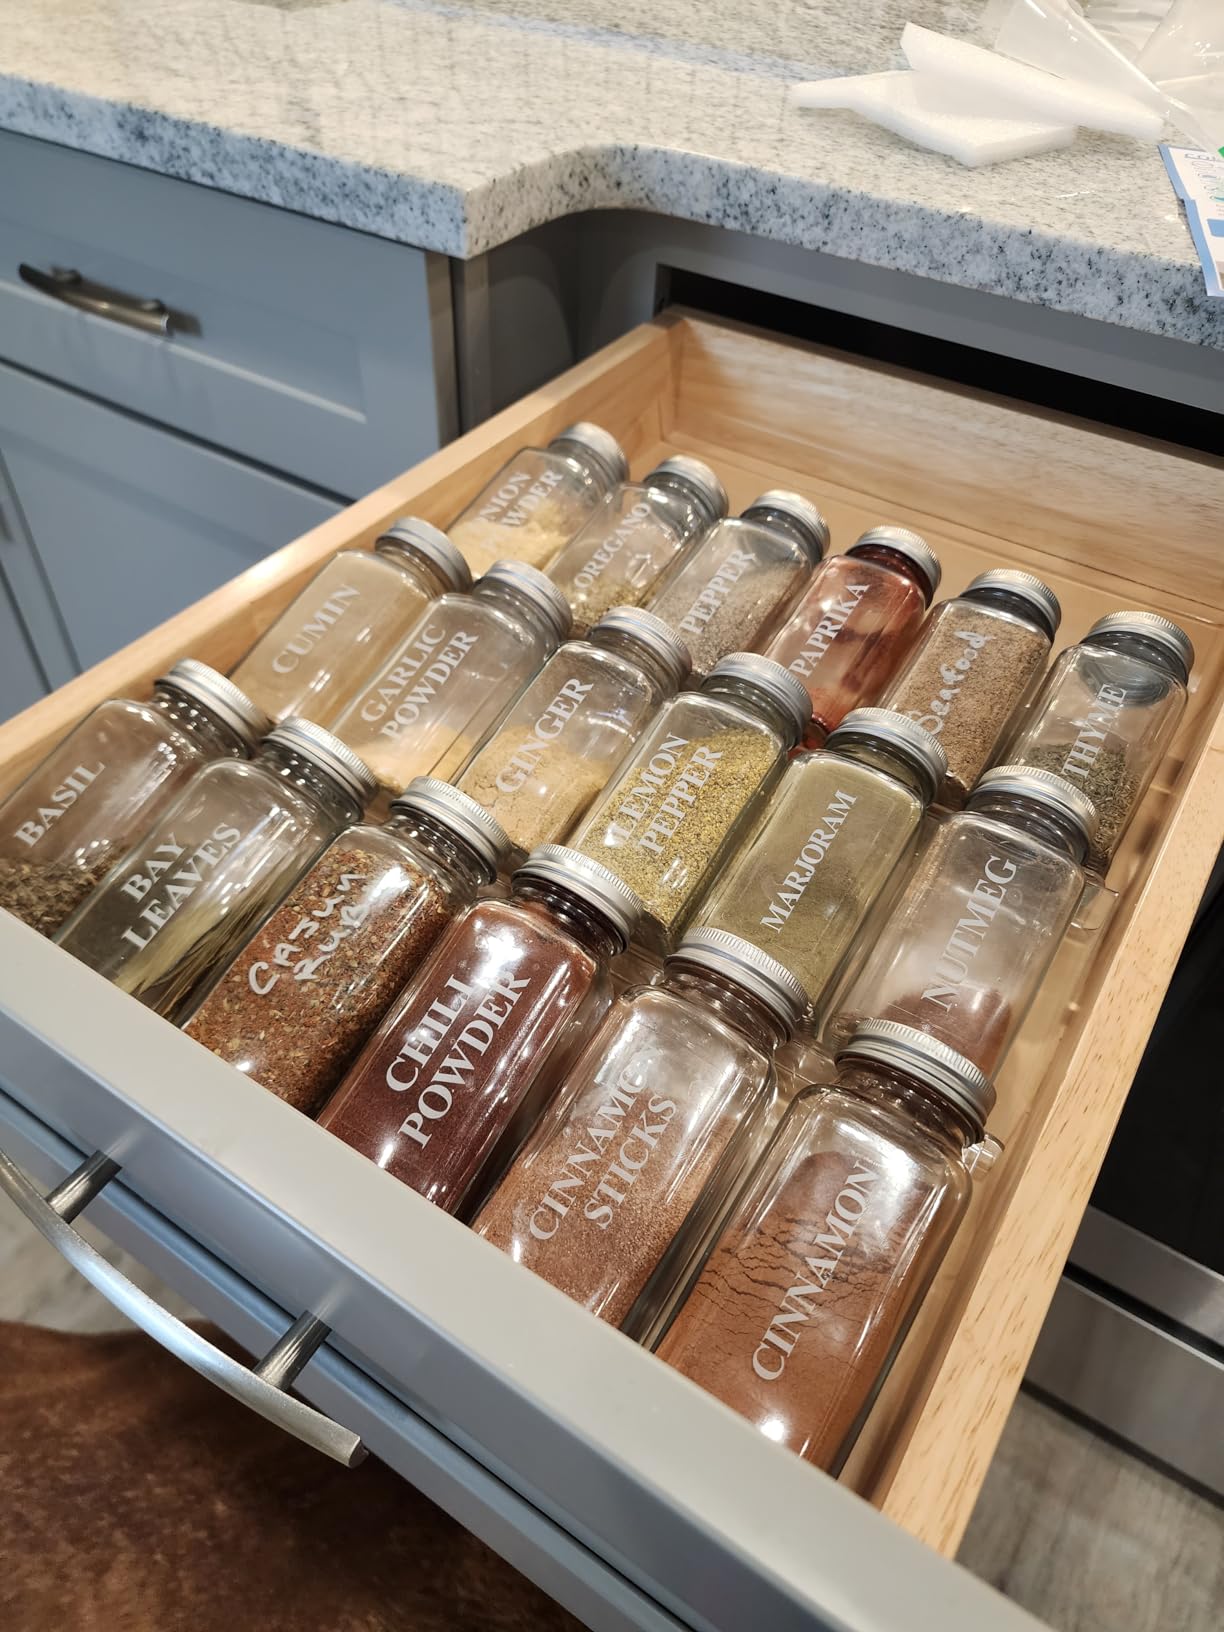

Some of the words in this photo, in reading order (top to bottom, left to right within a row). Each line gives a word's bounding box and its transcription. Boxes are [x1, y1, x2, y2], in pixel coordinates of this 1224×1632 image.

[574, 503, 651, 589] OREGANO
[680, 549, 756, 635] PEPPER
[272, 584, 361, 674] CUMIN
[361, 625, 446, 722] GARLIC
[788, 584, 870, 677] PAPRIKA
[379, 631, 479, 739] POWDER
[496, 679, 594, 792] GINGER
[1061, 684, 1128, 779] THYME
[15, 762, 106, 848] BASIL
[610, 733, 690, 840] LEMON
[639, 746, 724, 854] PEPPER
[121, 833, 188, 903] BAY
[121, 822, 241, 950] LEAVES
[760, 790, 857, 933] MARJORAM
[921, 855, 1019, 1012] NUTMEG
[386, 974, 474, 1092] CHILI
[397, 971, 531, 1149] POWDER
[584, 1094, 676, 1230] STICKS
[752, 1161, 883, 1381] CINNAMON
